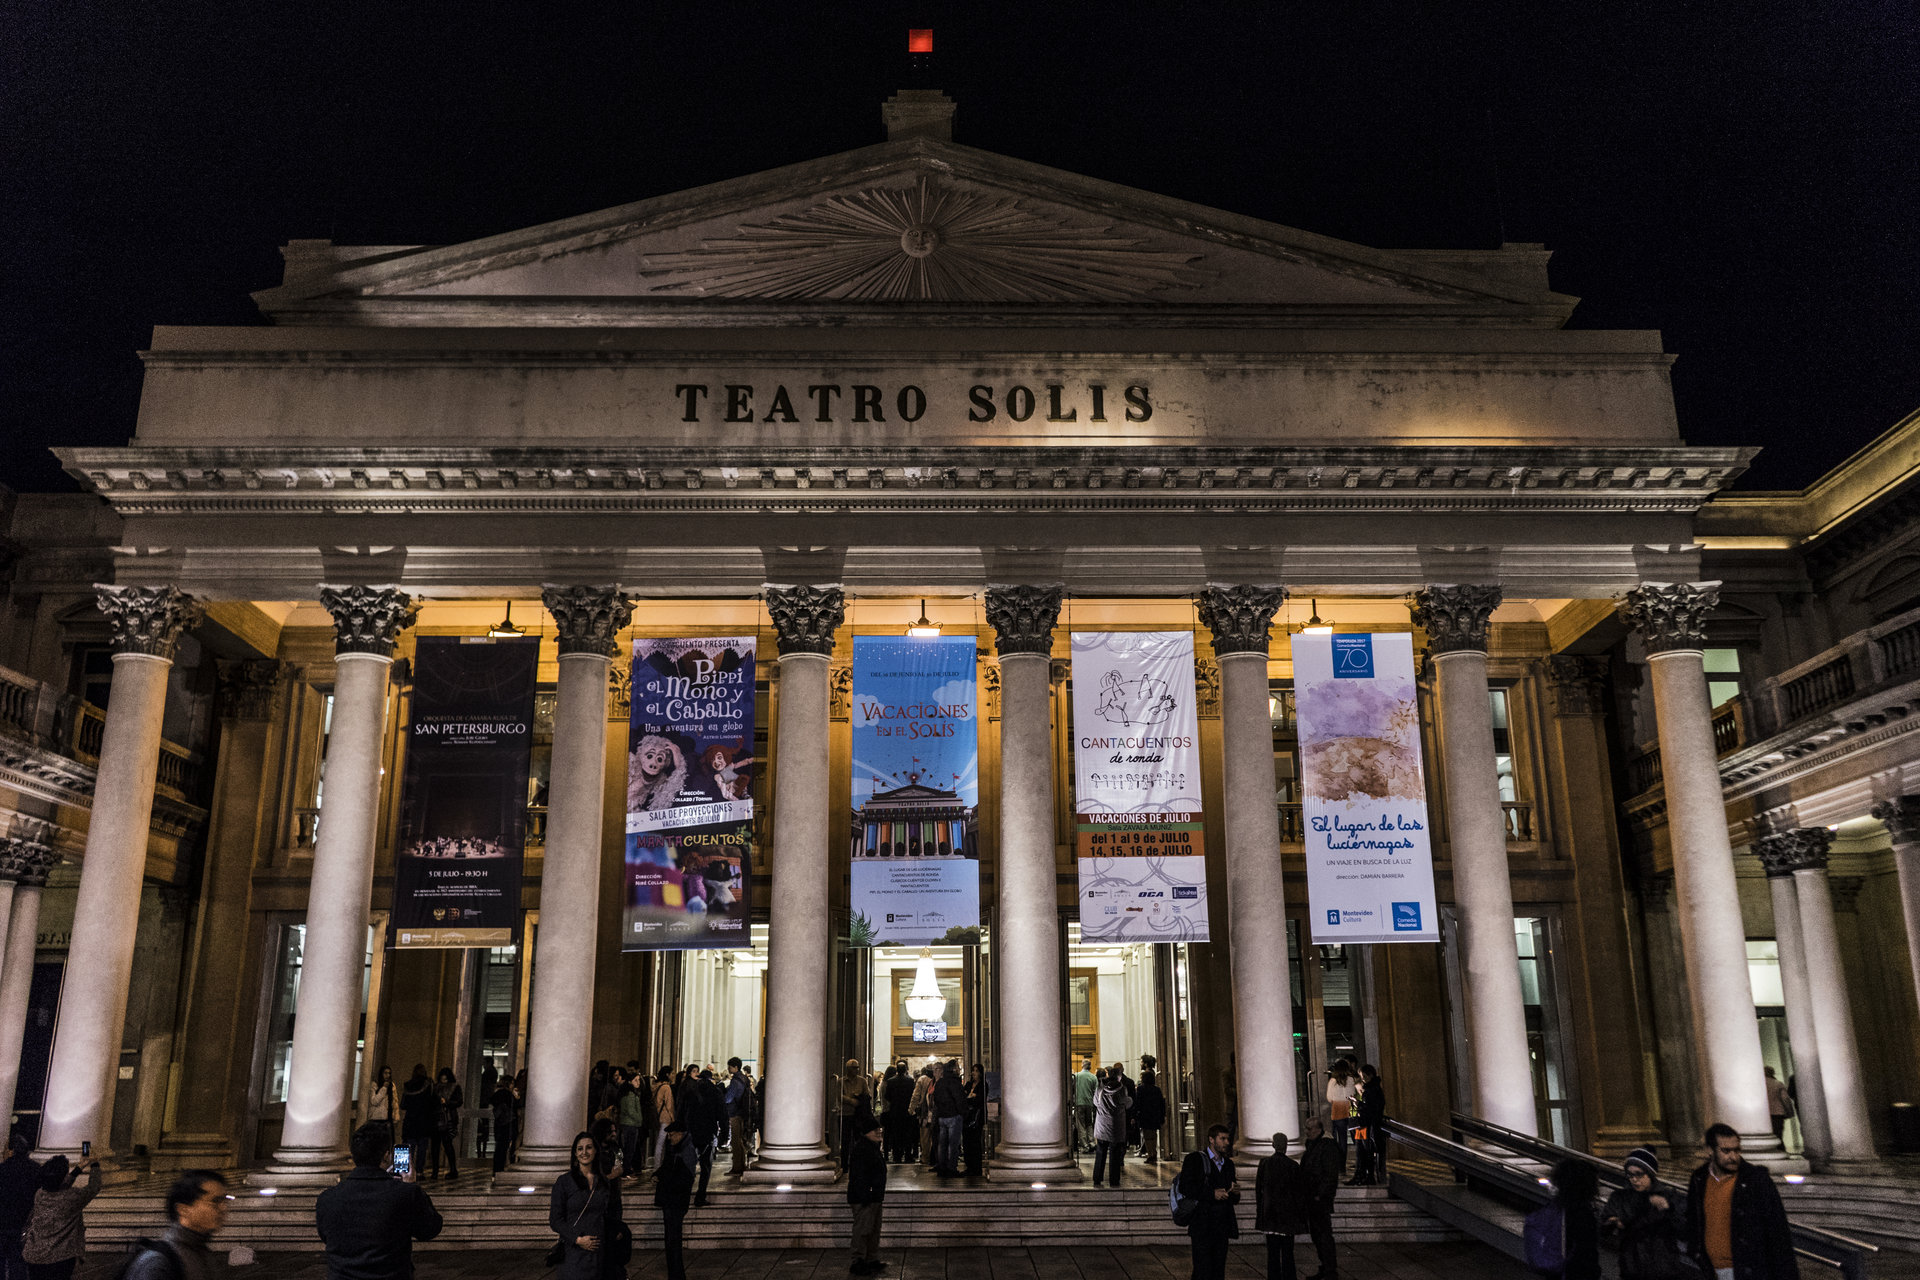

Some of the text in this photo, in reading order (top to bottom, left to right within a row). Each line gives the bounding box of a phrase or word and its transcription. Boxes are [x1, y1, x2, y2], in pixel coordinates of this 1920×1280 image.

[675, 384, 1154, 423] TEATRO SOLIS
[1336, 648, 1368, 668] 70
[692, 659, 744, 686] Pippi
[730, 689, 743, 703] y
[861, 702, 968, 720] VACACIONES
[415, 723, 526, 734] SAN PETERSBURGO
[645, 724, 661, 732] Una
[666, 723, 703, 732] aventura
[722, 721, 743, 732] globo
[876, 721, 954, 740] EN EL SOLÍS
[1081, 737, 1192, 748] CANTACUENTOS
[1110, 752, 1164, 763] de ronda
[649, 812, 666, 821] SALA
[680, 803, 733, 818] PROYECCIONES
[1089, 813, 1191, 824] VACACIONES DE JULIO
[662, 819, 696, 828] VACACIONES
[705, 814, 720, 823] JULIO
[1311, 814, 1423, 837] El lugar de las
[637, 834, 744, 848] MANTACUENTOS
[1092, 832, 1189, 844] del 1 al 9 de JULIO
[1327, 833, 1414, 855] luciérnagas
[1090, 845, 1192, 857] 14, 15, 16 de JULIO
